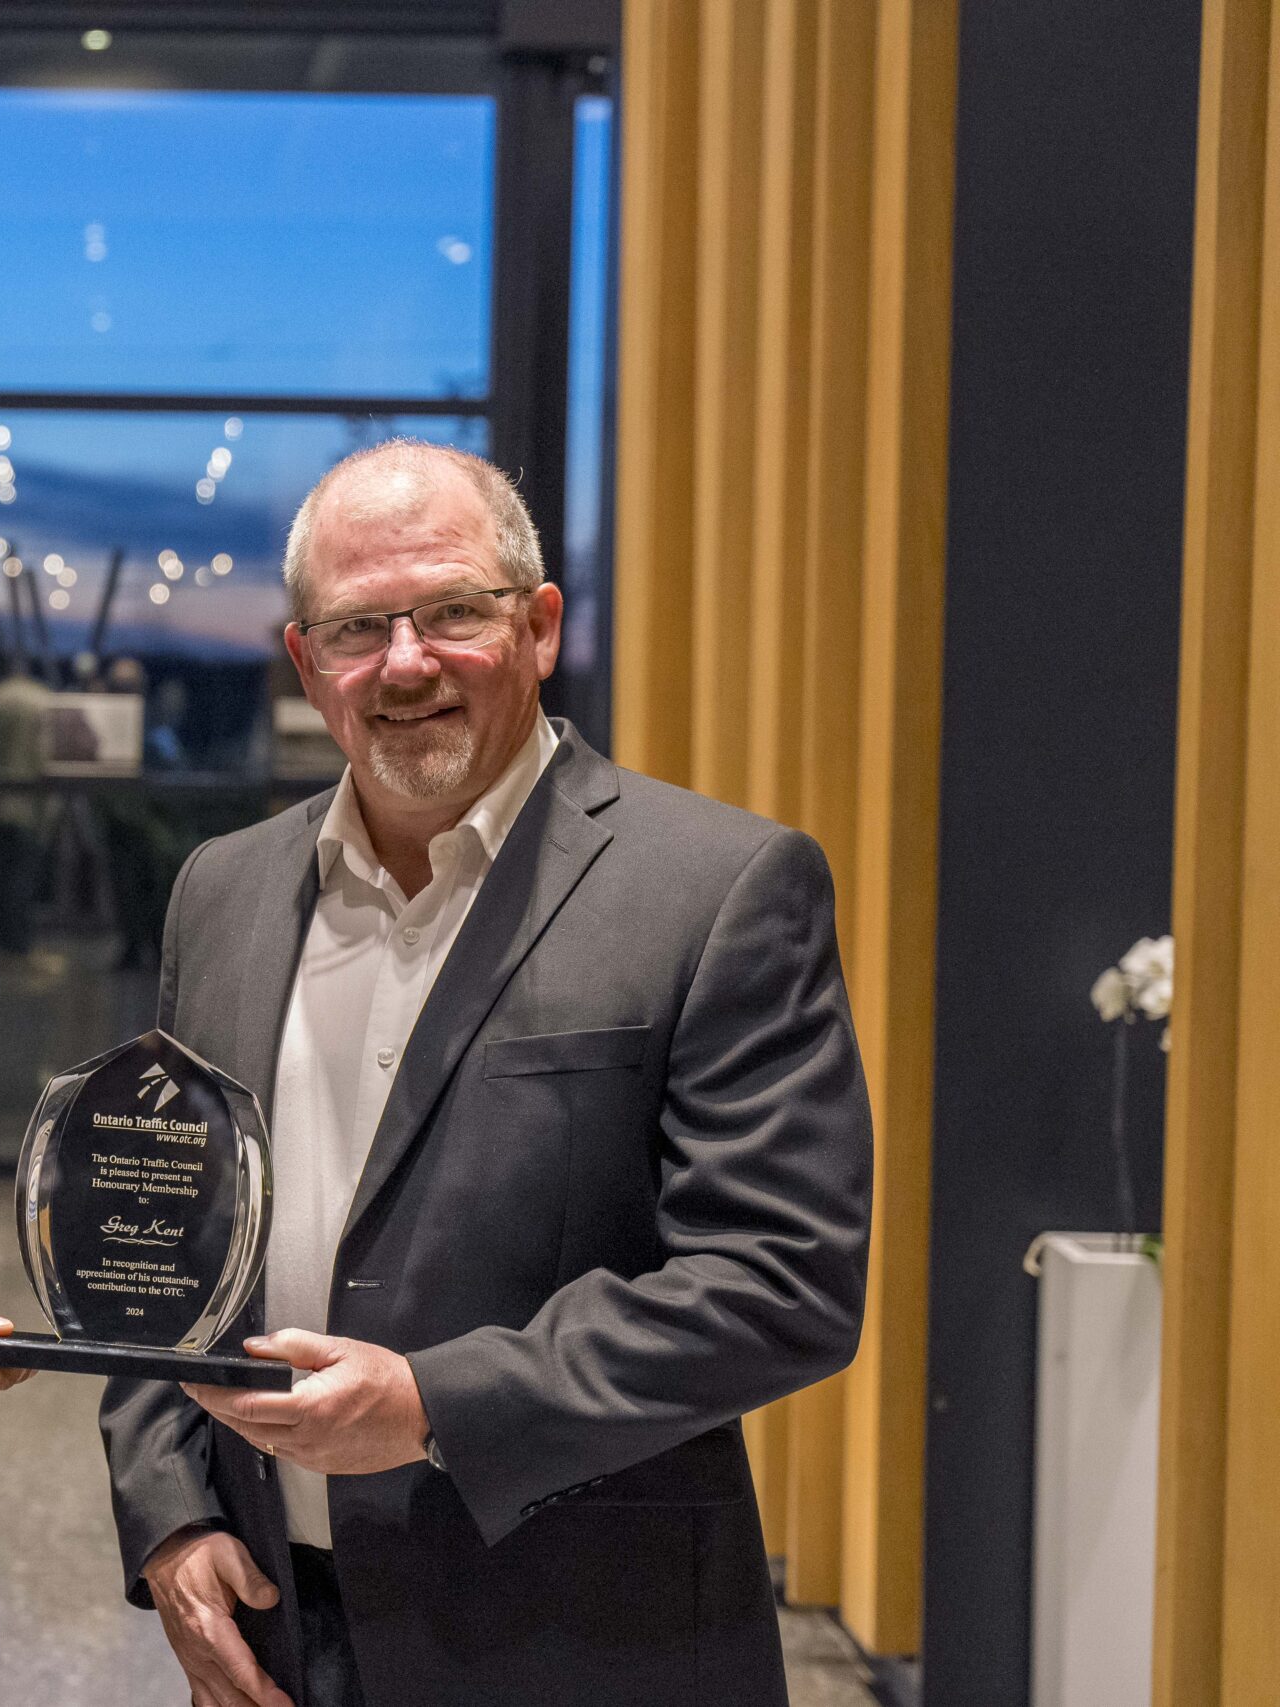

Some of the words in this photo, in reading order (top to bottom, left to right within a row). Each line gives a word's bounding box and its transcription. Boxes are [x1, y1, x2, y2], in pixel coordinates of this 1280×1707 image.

[93, 1113, 133, 1127] Ontario
[135, 1116, 168, 1130] Traffic
[169, 1120, 208, 1133] Council
[156, 1133, 207, 1147] www.otc.org
[91, 1153, 108, 1163] The
[109, 1155, 140, 1166] Ontario
[141, 1158, 169, 1168] Traffic
[171, 1161, 203, 1171] Council
[100, 1166, 107, 1175] is
[109, 1167, 140, 1178] pleased
[141, 1171, 149, 1179] to
[151, 1172, 181, 1181] present
[92, 1178, 140, 1193] Honourary
[142, 1182, 199, 1198] Membership
[138, 1196, 150, 1204] to:
[100, 1215, 139, 1236] Greg
[142, 1219, 184, 1237] Kent
[102, 1257, 111, 1267] In
[112, 1260, 158, 1270] recognition
[160, 1263, 175, 1272] and
[76, 1269, 126, 1280] appreciation
[127, 1272, 137, 1280] of
[138, 1273, 151, 1282] his
[152, 1276, 200, 1288] outstanding
[87, 1281, 136, 1292] contribution
[138, 1286, 147, 1294] to
[148, 1286, 161, 1295] the
[162, 1287, 186, 1297] OTC.
[125, 1307, 144, 1316] 2024
